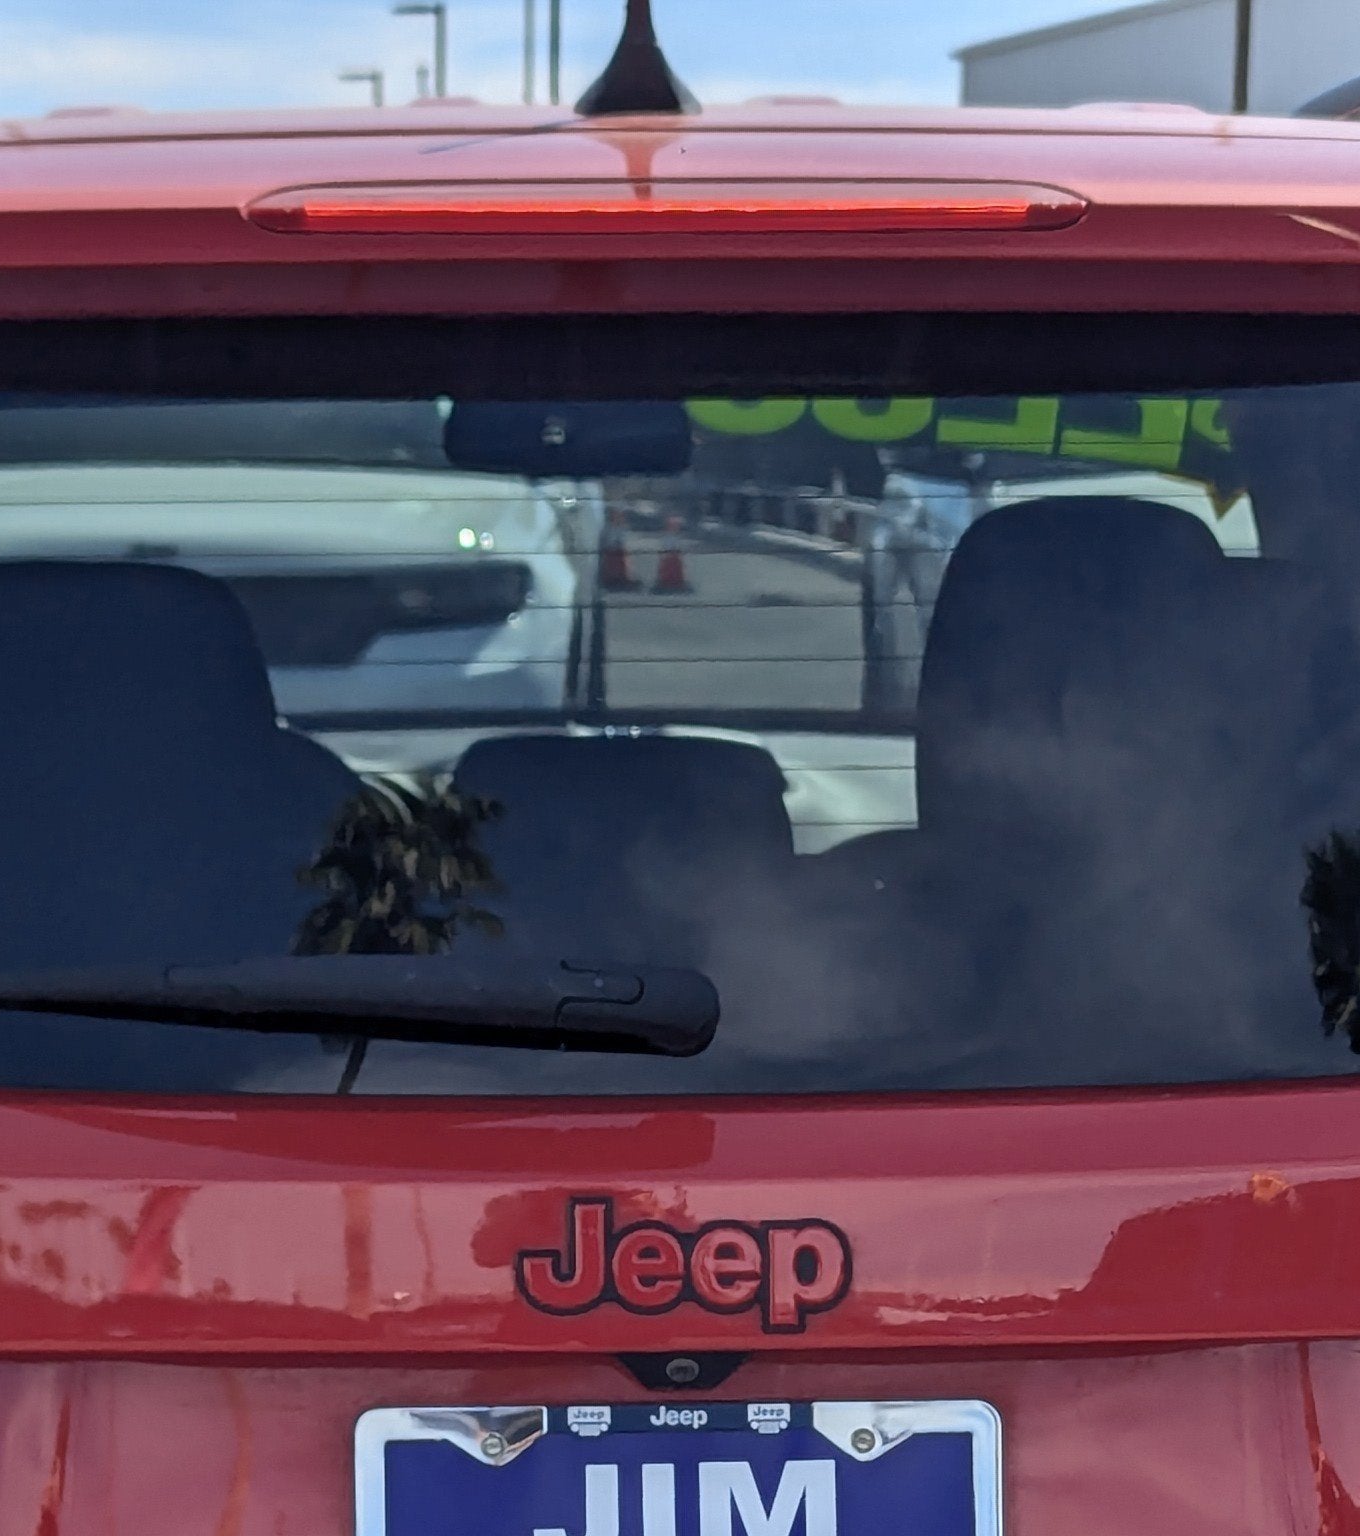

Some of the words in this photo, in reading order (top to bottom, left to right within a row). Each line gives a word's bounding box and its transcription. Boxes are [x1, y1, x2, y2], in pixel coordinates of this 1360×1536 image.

[514, 1196, 853, 1334] Jeep
[572, 1408, 606, 1421] Jeep
[649, 1405, 708, 1429] Jeep
[752, 1405, 786, 1418] Jeep
